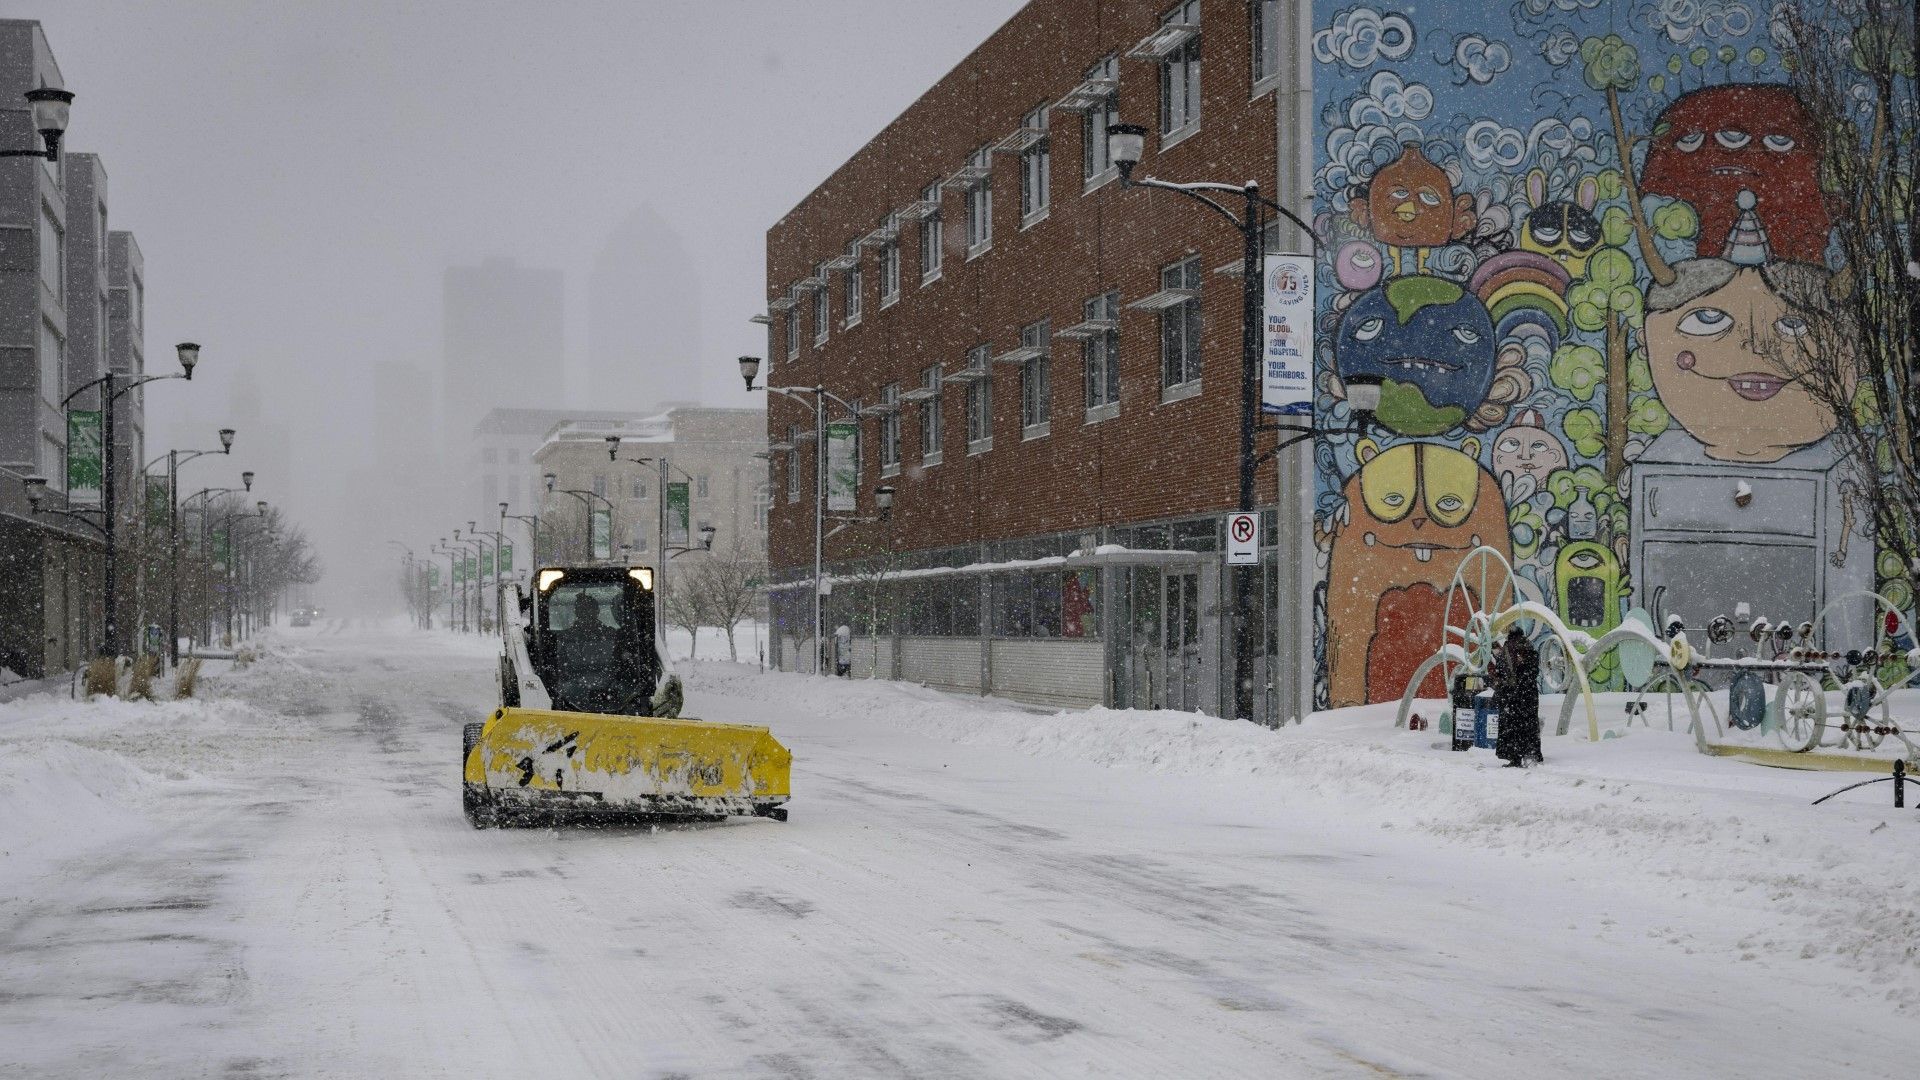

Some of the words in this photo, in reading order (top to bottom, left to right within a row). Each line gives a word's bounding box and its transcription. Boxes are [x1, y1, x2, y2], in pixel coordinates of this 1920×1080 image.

[1281, 275, 1297, 291] 75
[1279, 295, 1303, 306] SAVING
[1268, 324, 1293, 333] BLOOD.
[1268, 361, 1286, 370] YOUR
[1268, 370, 1308, 380] NEIGHBORS.
[1238, 521, 1250, 537] P
